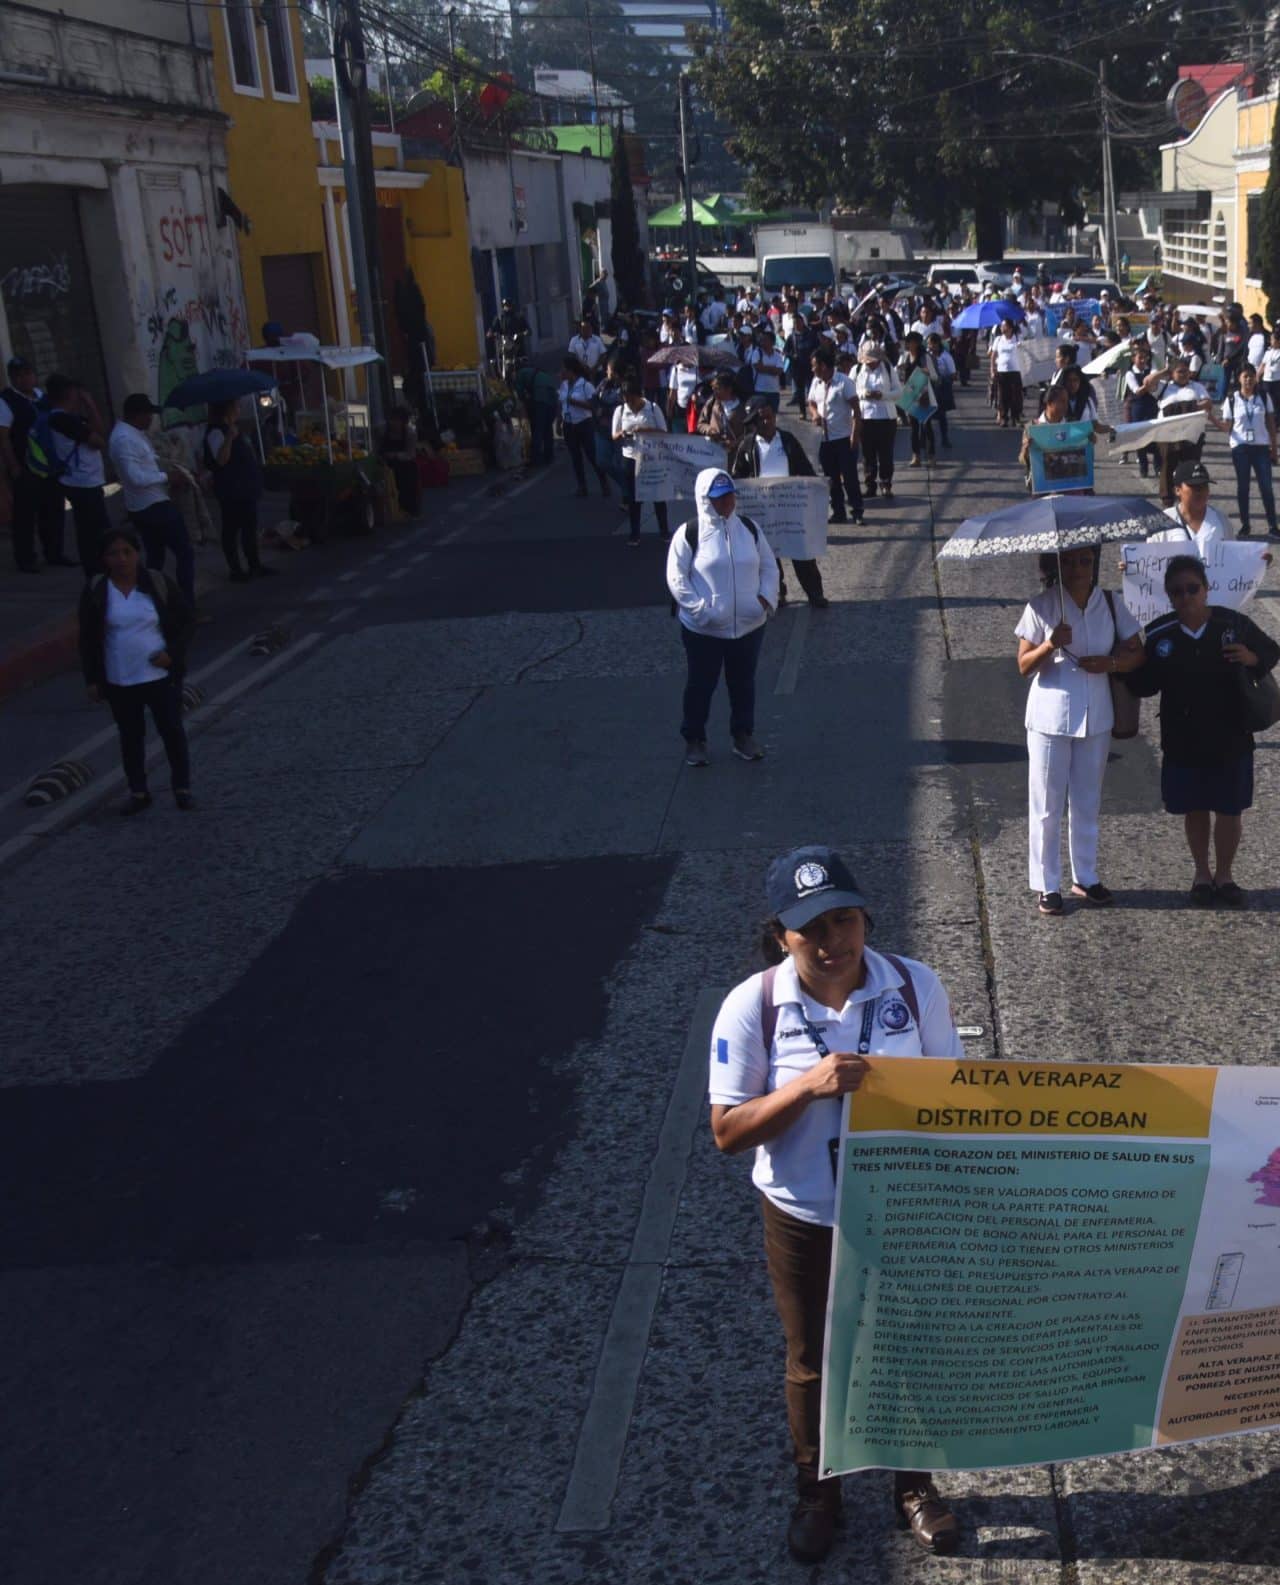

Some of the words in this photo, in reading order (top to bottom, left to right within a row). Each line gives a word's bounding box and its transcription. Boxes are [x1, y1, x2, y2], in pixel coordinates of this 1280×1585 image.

[951, 1068, 1010, 1085] ALTA
[1019, 1071, 1123, 1088] VERAPAZ
[917, 1108, 1022, 1127] DISTRITO
[1030, 1110, 1060, 1127] DE
[1067, 1110, 1148, 1128] COBAN
[853, 1147, 930, 1157] ENFERMERIA
[934, 1149, 993, 1160] CORAZON
[996, 1151, 1017, 1160] DEL
[1021, 1149, 1090, 1161] MINISTERIO
[1094, 1152, 1110, 1161] DE
[1112, 1152, 1150, 1162] SALUD
[1154, 1153, 1169, 1163] EN
[1171, 1154, 1195, 1165] SUS
[852, 1163, 880, 1172] TRES
[884, 1162, 931, 1171] NIVELES
[935, 1163, 950, 1172] DE
[955, 1165, 1020, 1176] ATENCION:
[887, 1183, 970, 1194] NECESITAMOS
[974, 1187, 994, 1196] SER
[998, 1187, 1068, 1198] VALORADOS
[1071, 1188, 1109, 1199] COMO
[1112, 1190, 1158, 1199] GREMIO
[886, 1198, 961, 1208] ENFERMERIA
[965, 1200, 988, 1209] POR
[1008, 1202, 1045, 1212] PARTE
[1048, 1203, 1109, 1213] PATRONAL
[885, 1212, 974, 1223] DIGNIFICACION
[977, 1215, 997, 1224] DEL
[1001, 1215, 1060, 1226] PERSONAL
[882, 1228, 961, 1236] APROBACION
[983, 1229, 1018, 1240] BONO
[1021, 1229, 1060, 1240] ANUAL
[1063, 1231, 1093, 1240] PARA
[1112, 1228, 1168, 1239] PERSONAL
[882, 1241, 957, 1250] ENFERMERIA
[960, 1242, 998, 1253] COMO
[1019, 1244, 1060, 1255] TIENEN
[1064, 1244, 1101, 1254] OTROS
[1104, 1241, 1174, 1252] MINISTERIOS
[880, 1255, 906, 1265] QUE
[910, 1256, 965, 1265] VALORAN
[880, 1269, 941, 1278] AUMENTO
[944, 1270, 963, 1278] DEL
[969, 1271, 1048, 1280] PRESUPUESTO
[1052, 1271, 1081, 1279] PARA
[1083, 1266, 1111, 1277] ALTA
[1114, 1266, 1163, 1275] VERAPAZ
[896, 1284, 953, 1292] MILLONES
[878, 1295, 938, 1305] TRASLADO
[965, 1296, 1024, 1306] PERSONAL
[1026, 1297, 1048, 1305] POR
[1052, 1291, 1114, 1302] CONTRATO
[877, 1306, 931, 1317] RENGLON
[1202, 1312, 1266, 1325] GARANTIZAR
[875, 1319, 956, 1330] SEGUIMIENTO
[986, 1319, 1041, 1330] CREACION
[1062, 1314, 1100, 1323] PLAZAS
[1122, 1312, 1141, 1320] LAS
[1185, 1324, 1252, 1336] ENFERMEROS
[1255, 1319, 1276, 1328] QUE
[874, 1331, 942, 1342] DIFERENTES
[945, 1335, 1018, 1343] DIRECCIONES
[1182, 1338, 1208, 1346] PARA
[872, 1344, 908, 1353] REDES
[911, 1347, 978, 1355] INTEGRALES
[999, 1341, 1055, 1354] SERVICIOS
[1074, 1335, 1108, 1346] SALUD
[1181, 1342, 1244, 1356] TERRITORIOS
[872, 1356, 927, 1365] RESPETAR
[931, 1360, 989, 1368] PROCESOS
[1105, 1343, 1159, 1352] TRASLADO
[1226, 1354, 1273, 1365] VERAPAZ
[888, 1369, 946, 1379] PERSONAL
[975, 1371, 1009, 1379] PARTE
[1030, 1368, 1048, 1376] LAS
[1052, 1355, 1125, 1372] AUTORIDADES
[1082, 1366, 1122, 1379] EQUIPO
[1177, 1370, 1225, 1382] GRANDES
[868, 1391, 921, 1401] INSUMOS
[960, 1393, 1015, 1402] SERVICIOS
[1034, 1387, 1069, 1400] SALUD
[1072, 1382, 1098, 1392] PARA
[1101, 1376, 1147, 1388] BRINDAR
[1185, 1380, 1232, 1392] POBREZA
[868, 1403, 925, 1414] ATENCION
[955, 1404, 1017, 1414] POBLACION
[1038, 1397, 1085, 1408] GENERAL
[866, 1415, 917, 1425] CARRERA
[1033, 1405, 1099, 1419] ENFERMERIA
[1167, 1408, 1238, 1425] AUTORIDADES
[1240, 1404, 1261, 1413] POR
